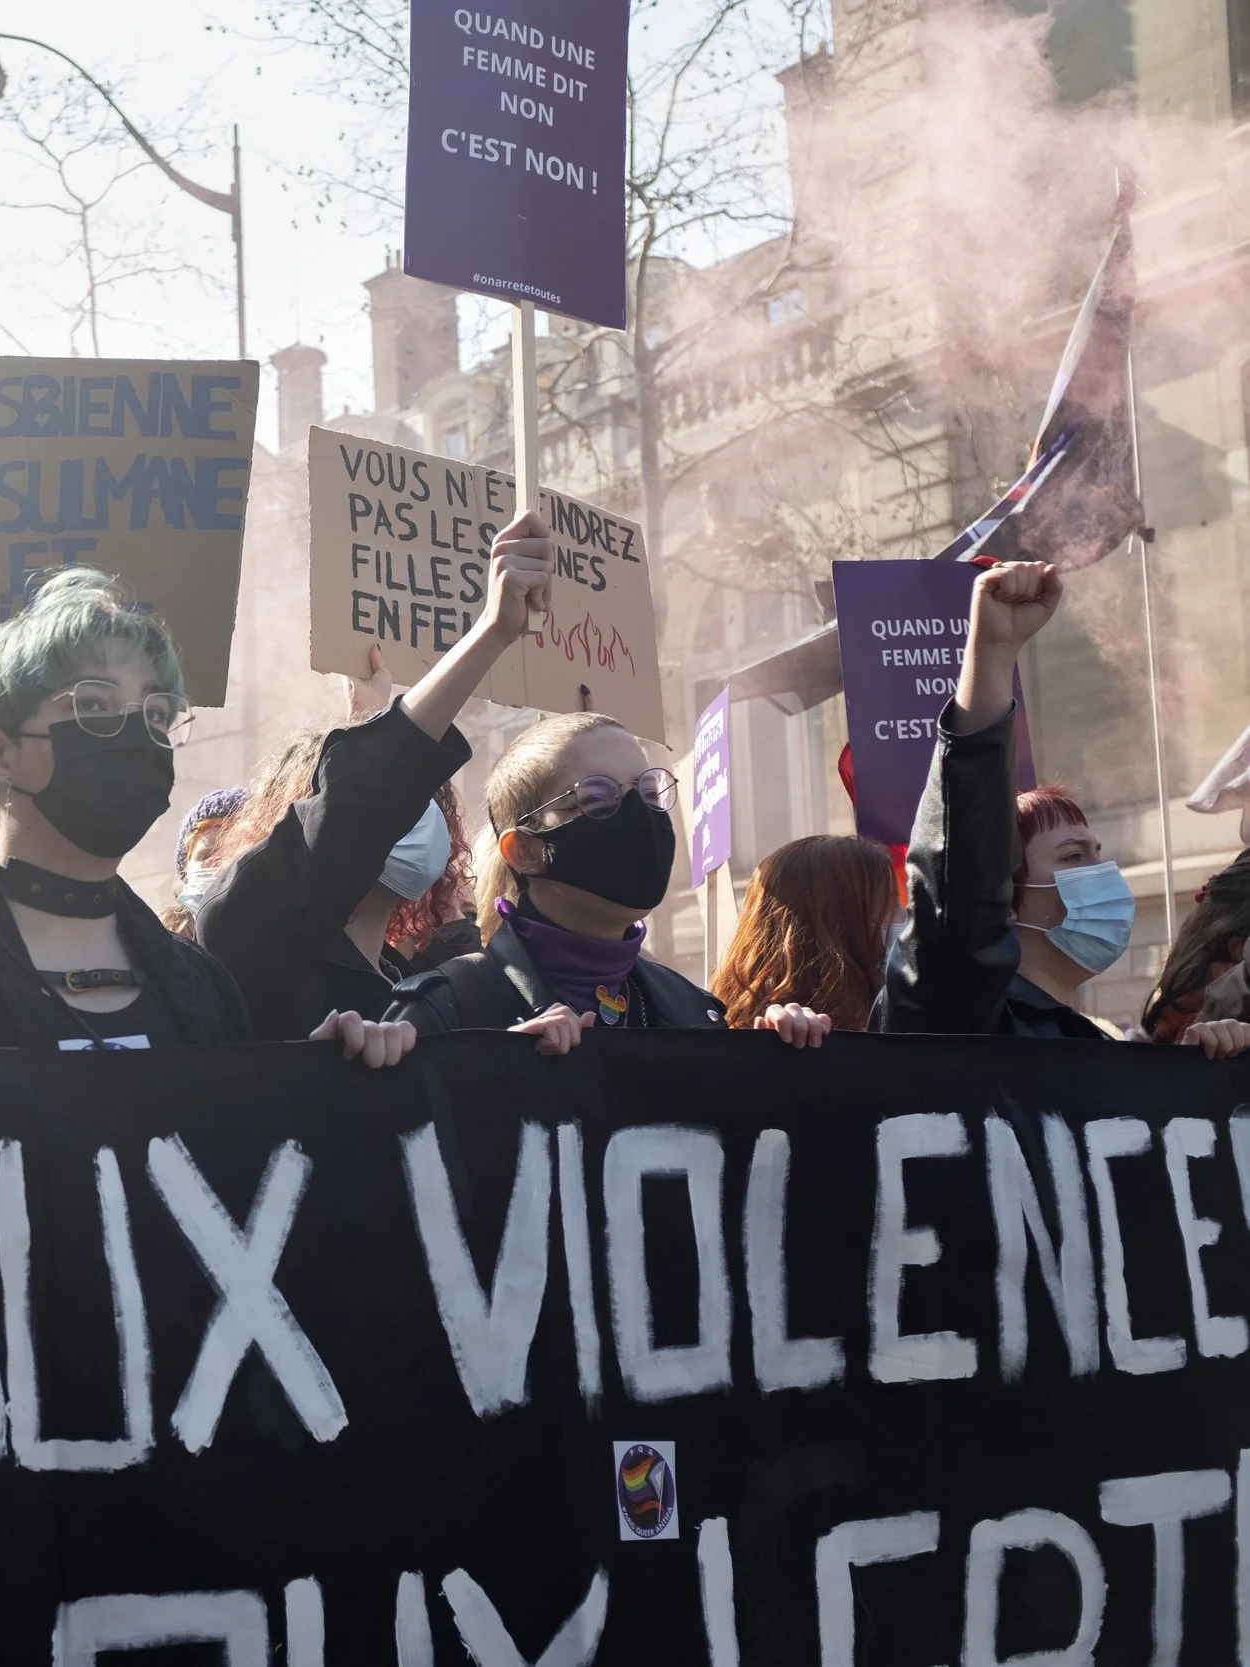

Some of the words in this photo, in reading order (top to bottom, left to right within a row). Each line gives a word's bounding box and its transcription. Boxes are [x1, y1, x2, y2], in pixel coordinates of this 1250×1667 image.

[453, 8, 545, 50] QUAND
[551, 35, 596, 71] UNE
[462, 45, 547, 88] FEMME
[552, 72, 588, 102] DIT
[499, 91, 554, 127] NON
[441, 128, 517, 166] C'EST
[525, 148, 584, 190] NON
[472, 272, 562, 305] #onarretetoutes
[339, 444, 431, 503] VOUS
[348, 493, 419, 542] PAS
[430, 510, 500, 560] LES
[351, 543, 485, 604] FILLES
[351, 589, 402, 643] EN
[870, 618, 946, 641] QUAND
[881, 648, 952, 667] FEMME
[915, 678, 960, 696] NON
[874, 718, 936, 741] C'EST
[398, 1103, 1250, 1420] VIOLENCE
